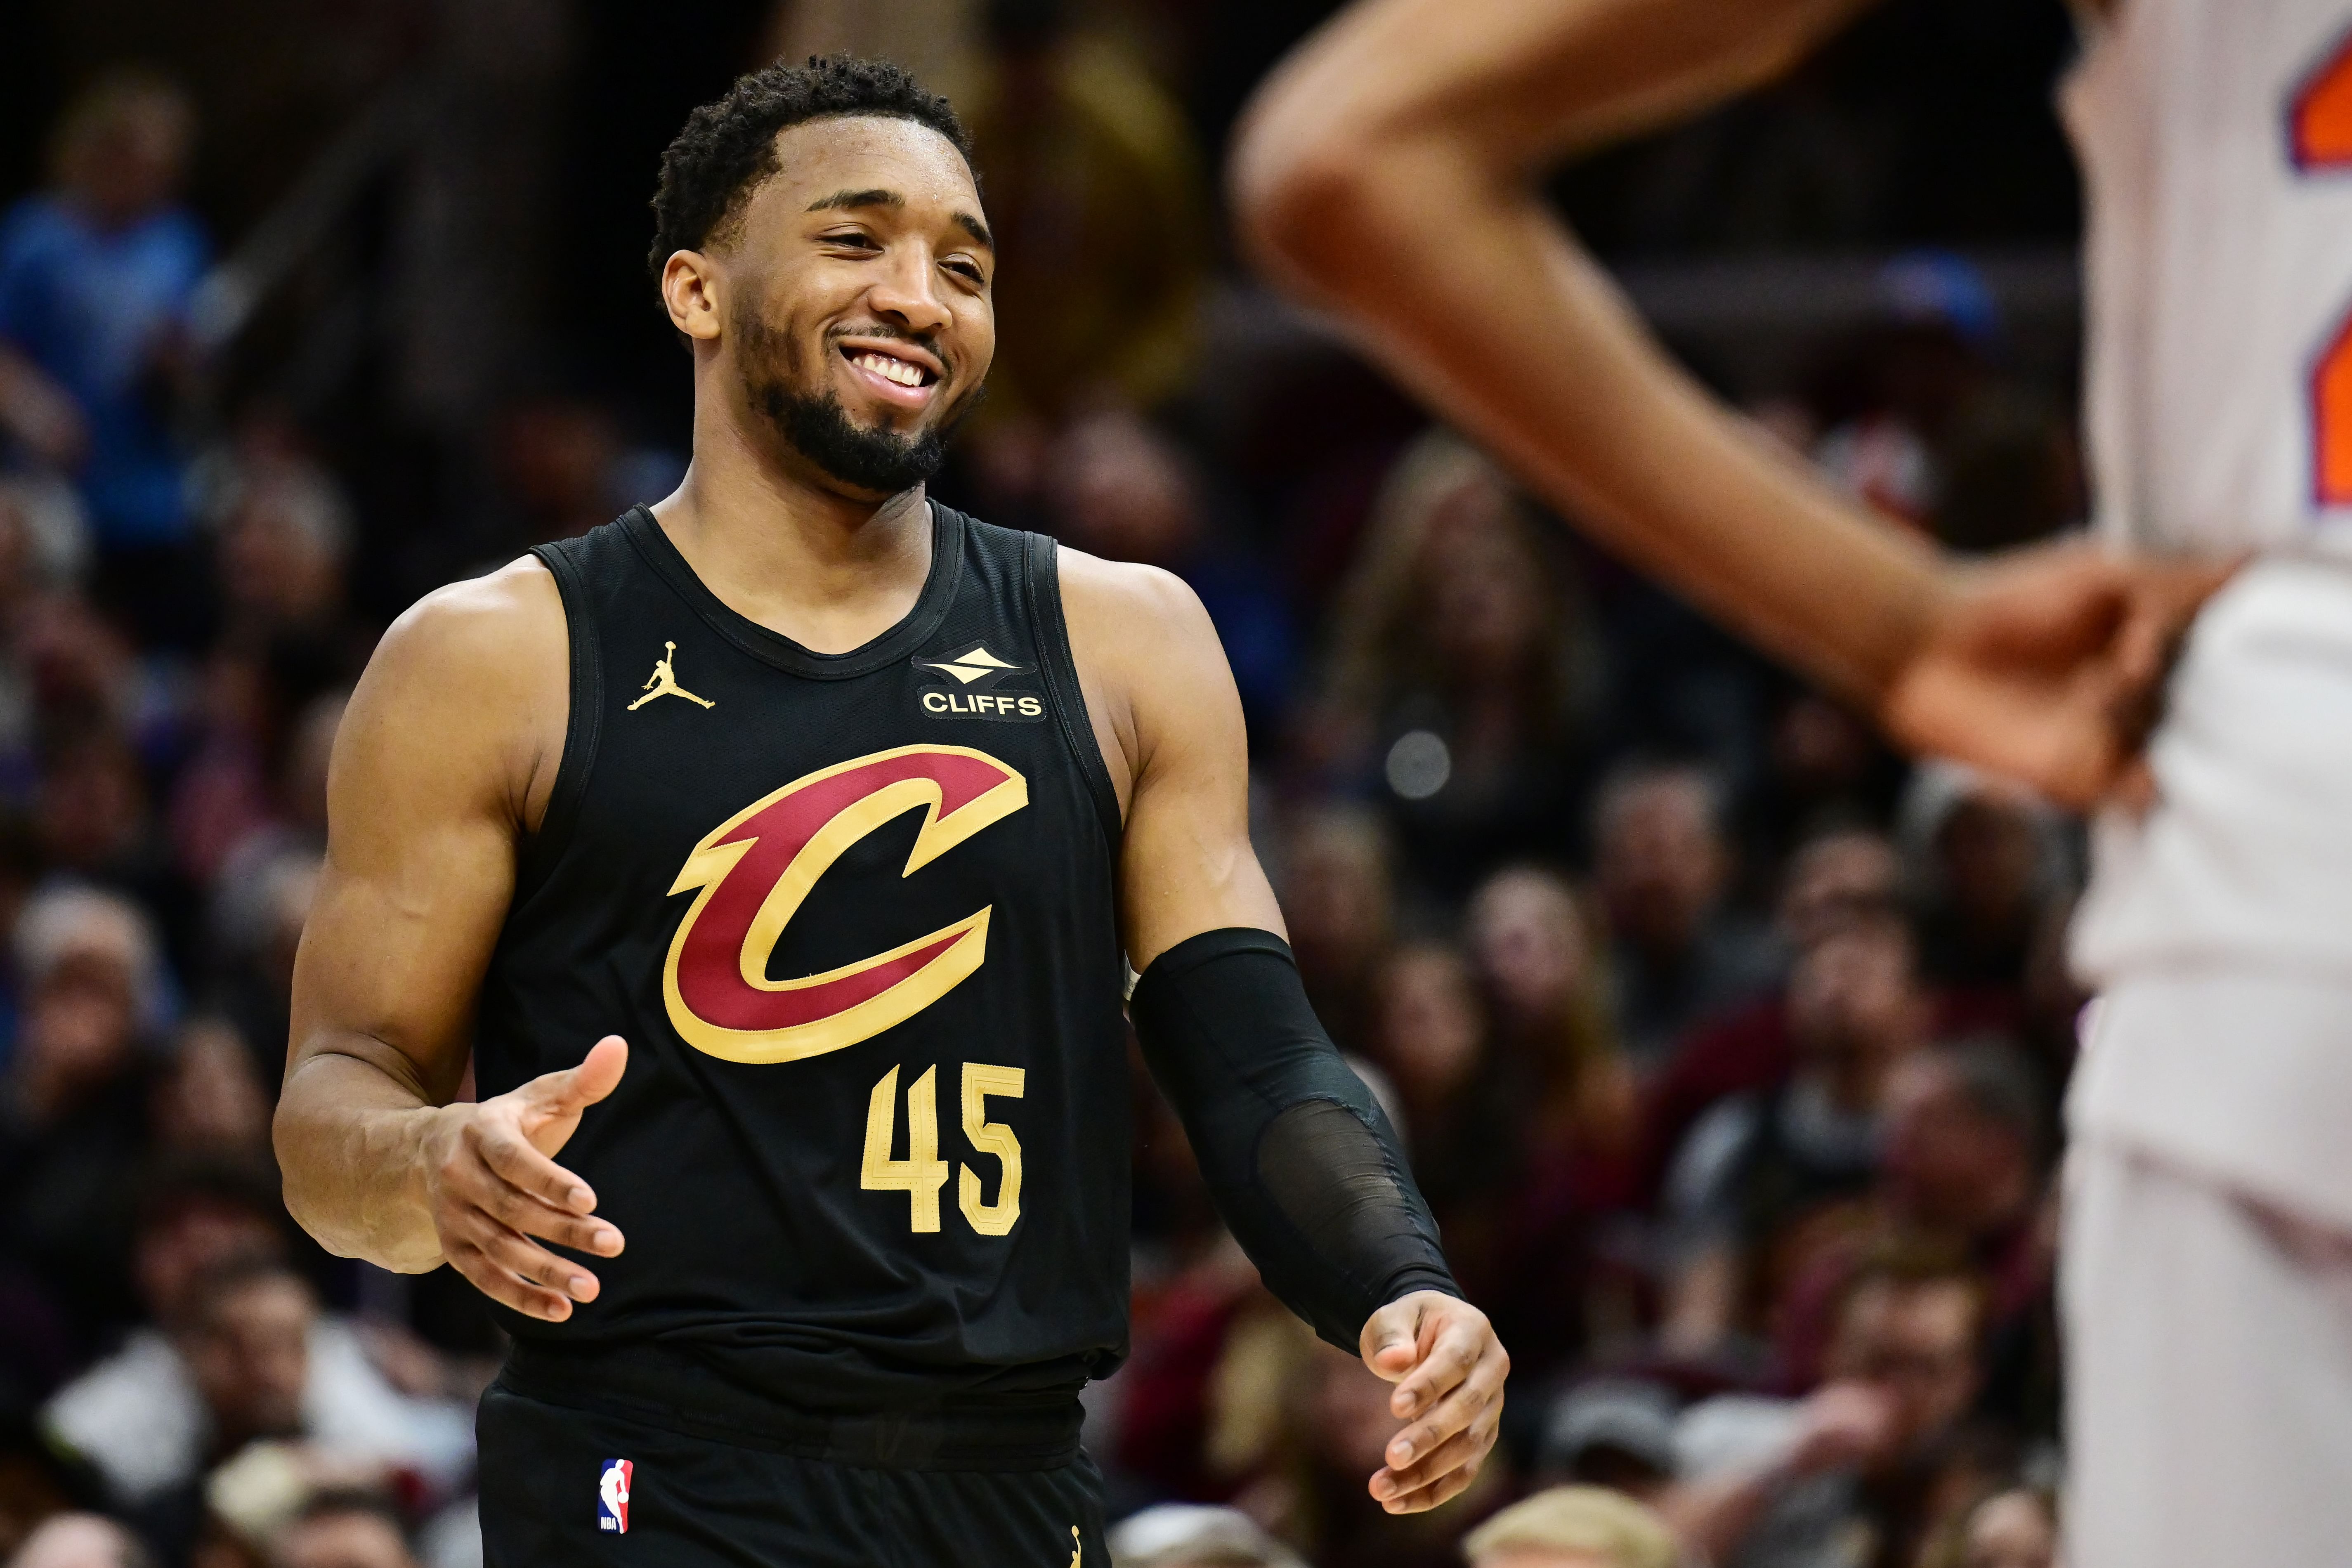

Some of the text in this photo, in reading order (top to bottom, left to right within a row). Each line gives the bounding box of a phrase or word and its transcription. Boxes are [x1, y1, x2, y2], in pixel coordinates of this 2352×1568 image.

[923, 693, 1042, 716] CLIFFS
[663, 744, 1029, 1063] C
[861, 1062, 1025, 1235] 45
[601, 1516, 616, 1530] NBA
